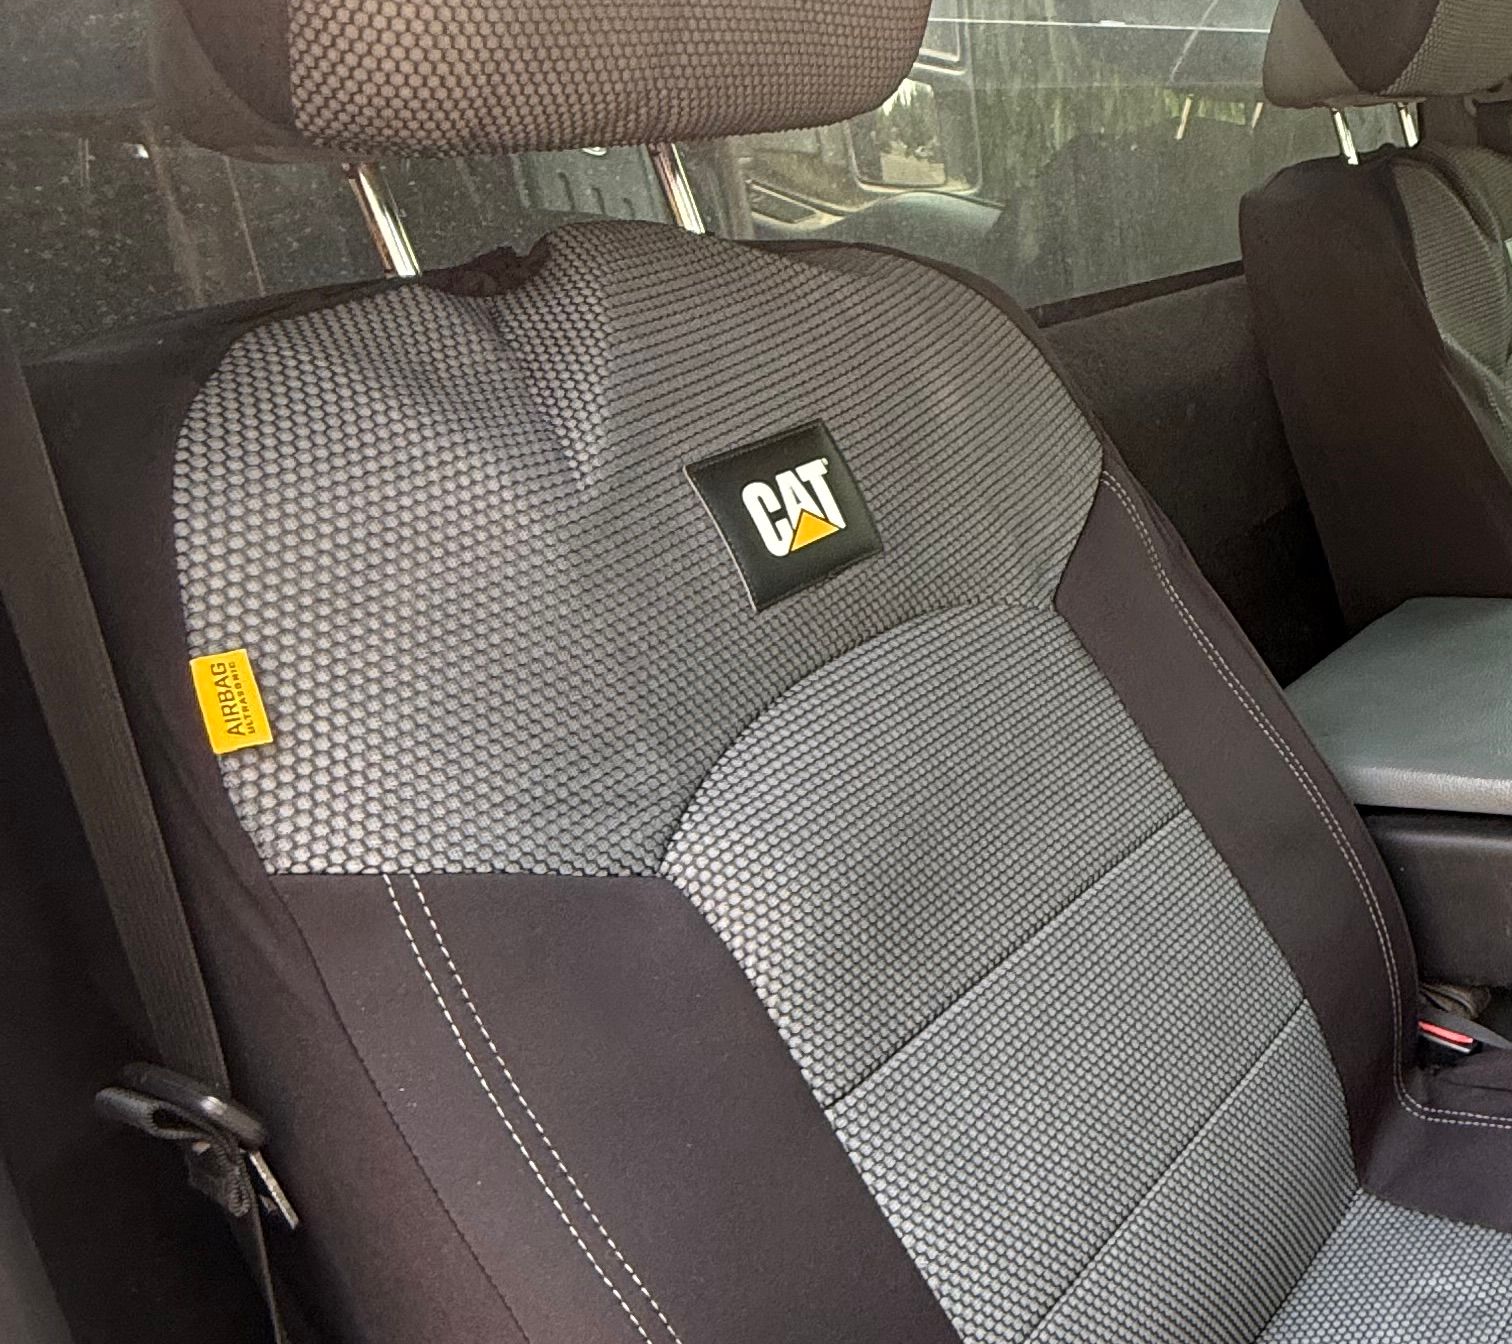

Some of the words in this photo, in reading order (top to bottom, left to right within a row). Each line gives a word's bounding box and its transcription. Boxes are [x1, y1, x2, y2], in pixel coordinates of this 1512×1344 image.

[742, 458, 847, 557] CAT
[210, 662, 246, 735] AIRBAG
[228, 661, 256, 734] ULTRASONIC
